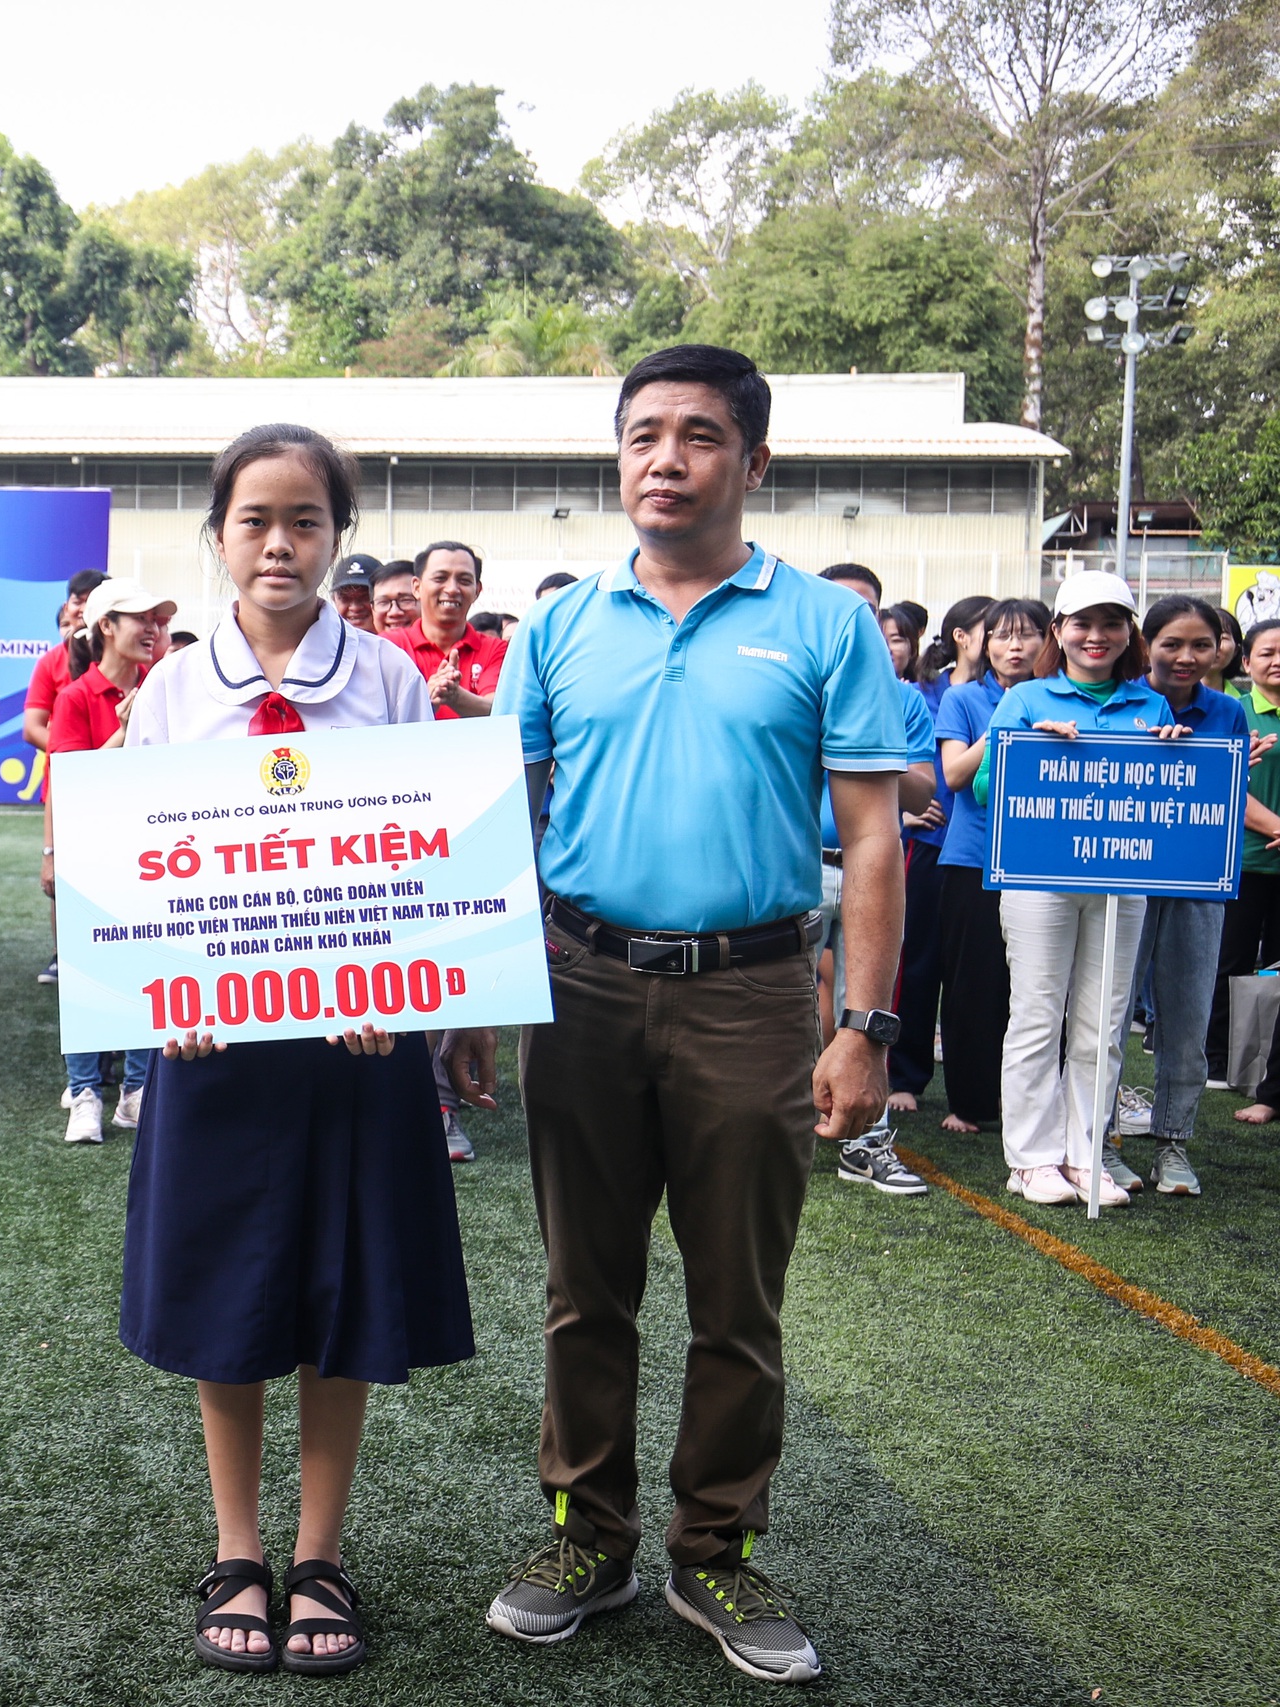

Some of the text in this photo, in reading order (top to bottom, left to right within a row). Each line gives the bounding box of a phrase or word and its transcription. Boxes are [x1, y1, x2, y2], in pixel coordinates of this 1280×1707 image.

[0, 642, 49, 655] MINH
[1039, 755, 1197, 792] PHÂN HIỆU HỌC VIỆN
[147, 792, 431, 824] CÔNG ĐOÀN CƠ QUAN TRUNG ƯƠNG ĐOÀN
[1007, 792, 1225, 829] THANH THIẾU NIÊN VIỆT NAM
[138, 822, 449, 882] SỔ TIẾT KIỆM
[1072, 836, 1153, 864] TẠI TPHCM
[167, 881, 424, 913] TẶNG CON CÁN BỘ, CÔNG ĐOÀN VIÊN
[93, 898, 507, 942] PHÂN HIỆU HỌC VIỆN THANH THIẾU NIÊN VIỆT NAM TẠI TP.HCM
[206, 930, 392, 957] CÓ HOÀN CẢNH KHÓ KHĂN
